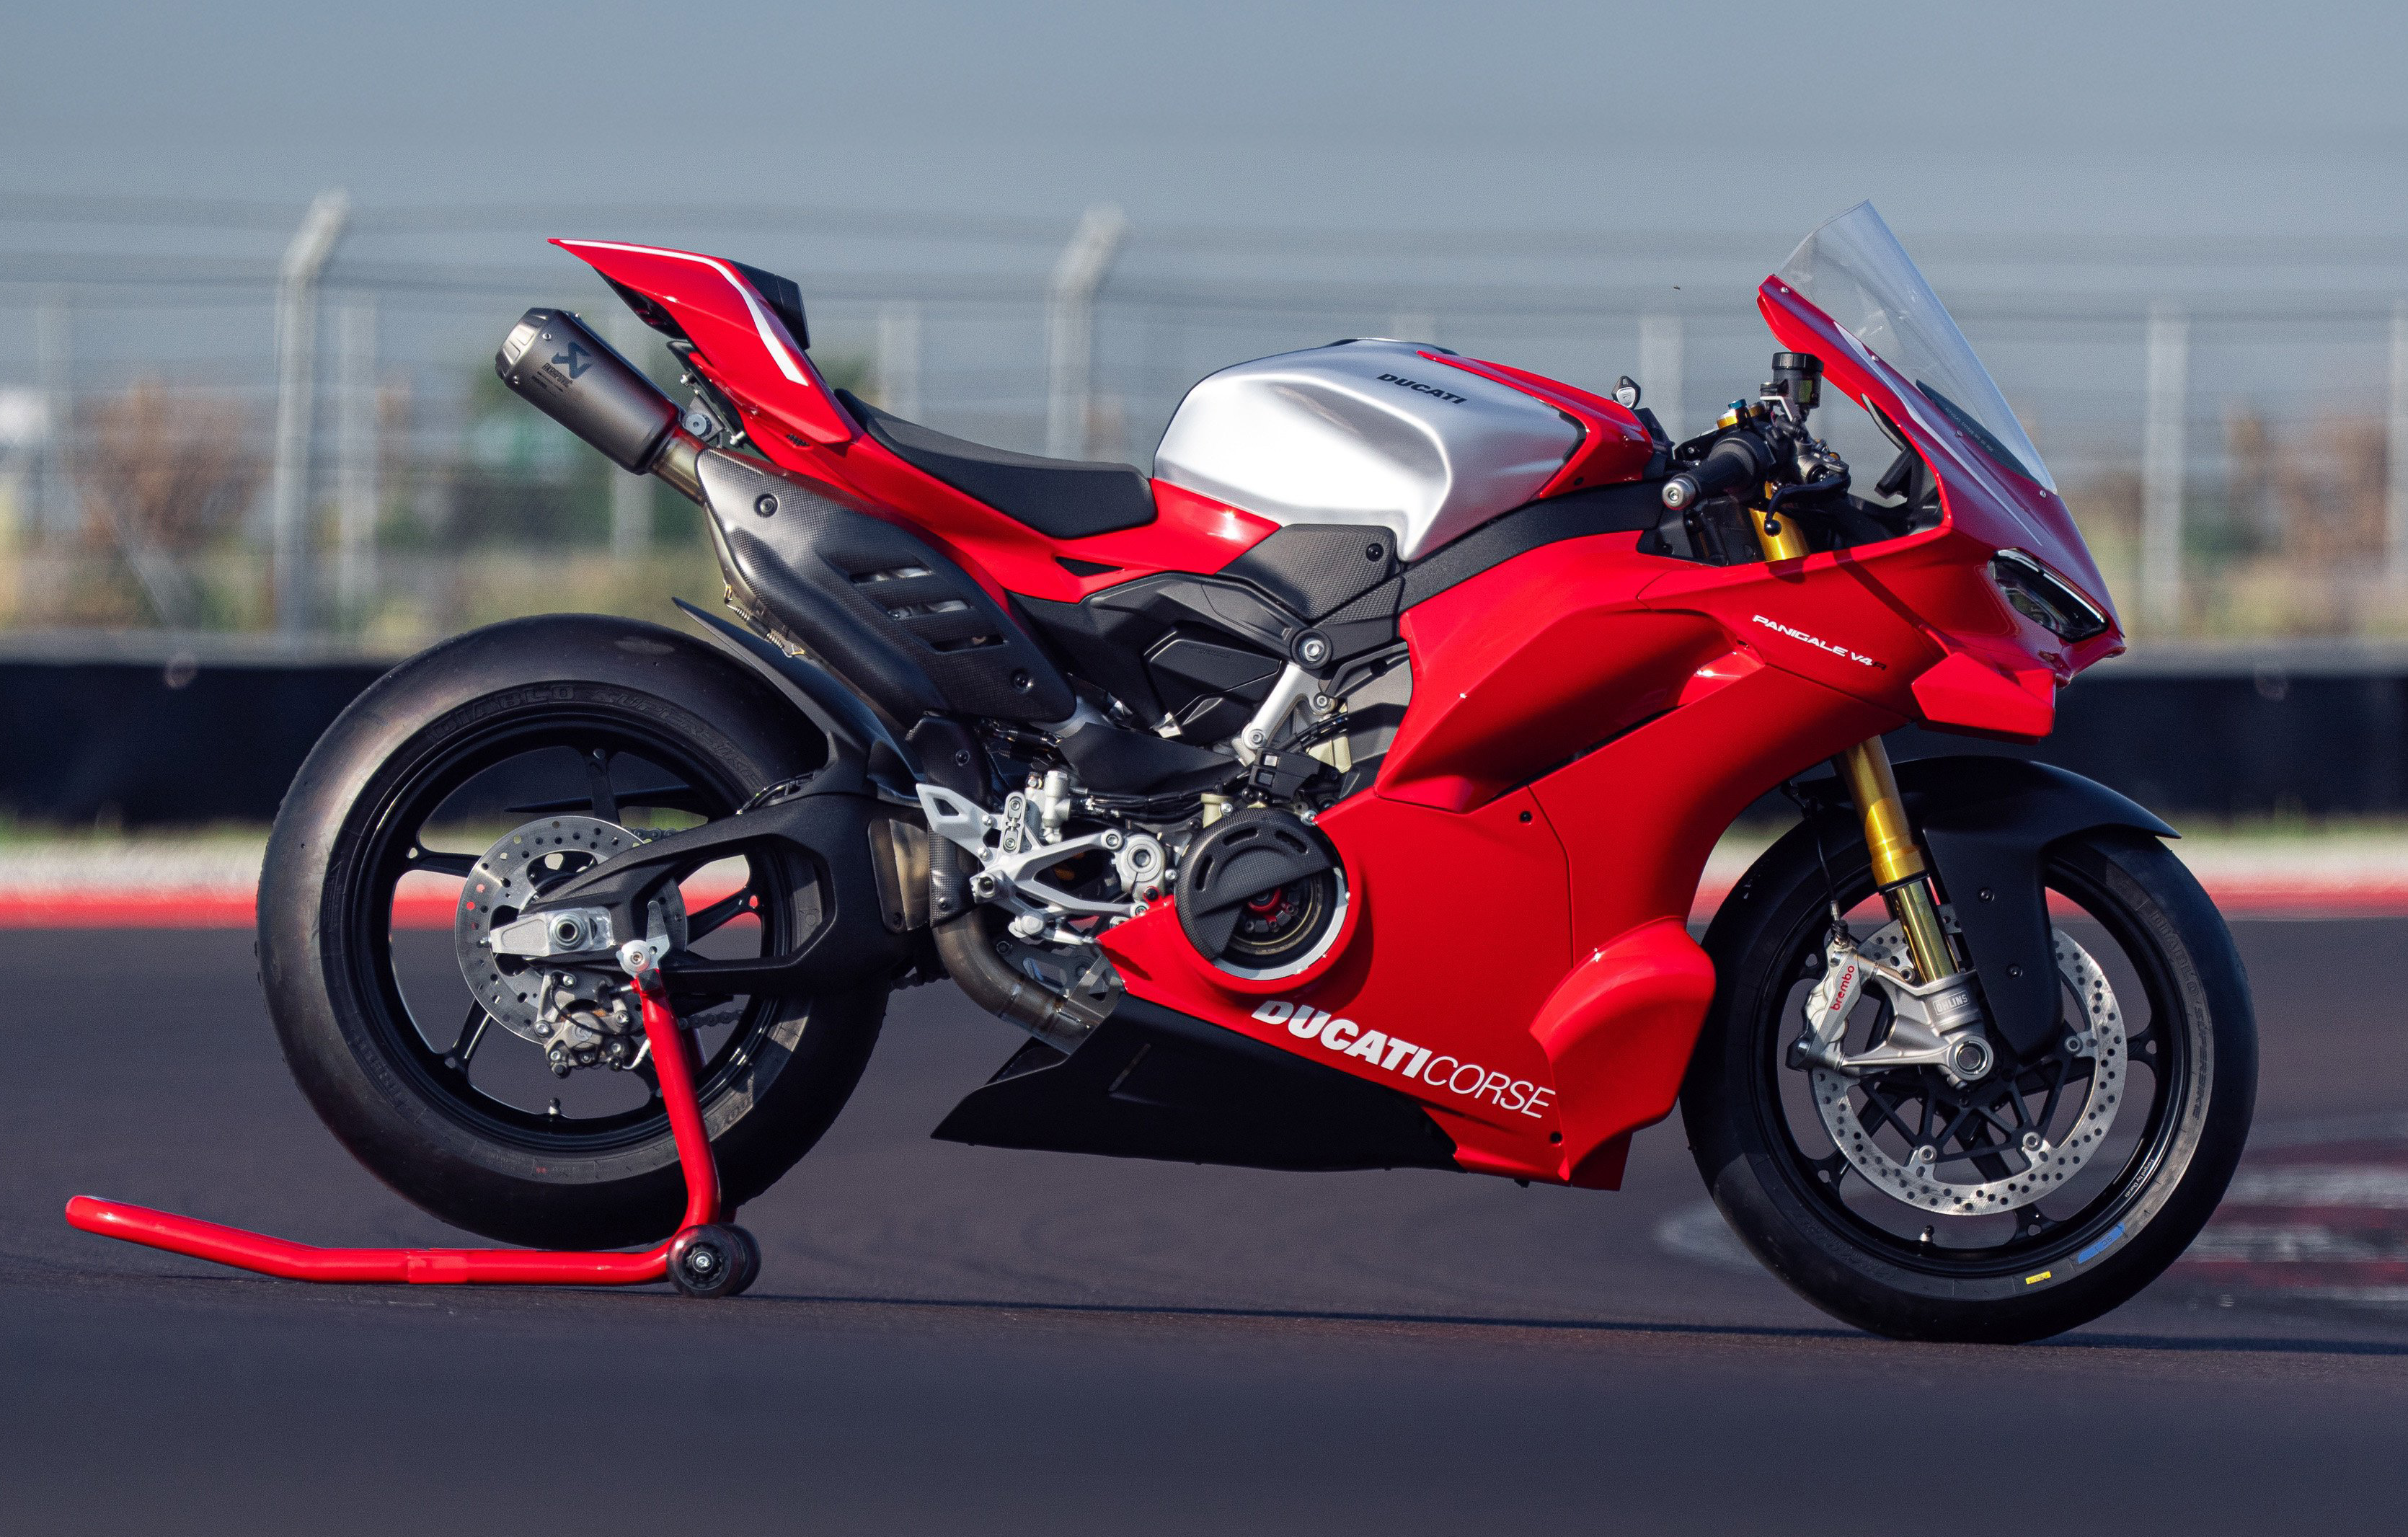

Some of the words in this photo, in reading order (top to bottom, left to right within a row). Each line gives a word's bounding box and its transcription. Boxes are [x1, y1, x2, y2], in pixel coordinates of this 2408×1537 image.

[1376, 373, 1468, 404] DUCATI
[1752, 614, 1848, 657] PANIGALE
[429, 683, 574, 741] DIABLO
[1831, 965, 1855, 1011] brembo
[2190, 1006, 2208, 1120] SUPERBIKE
